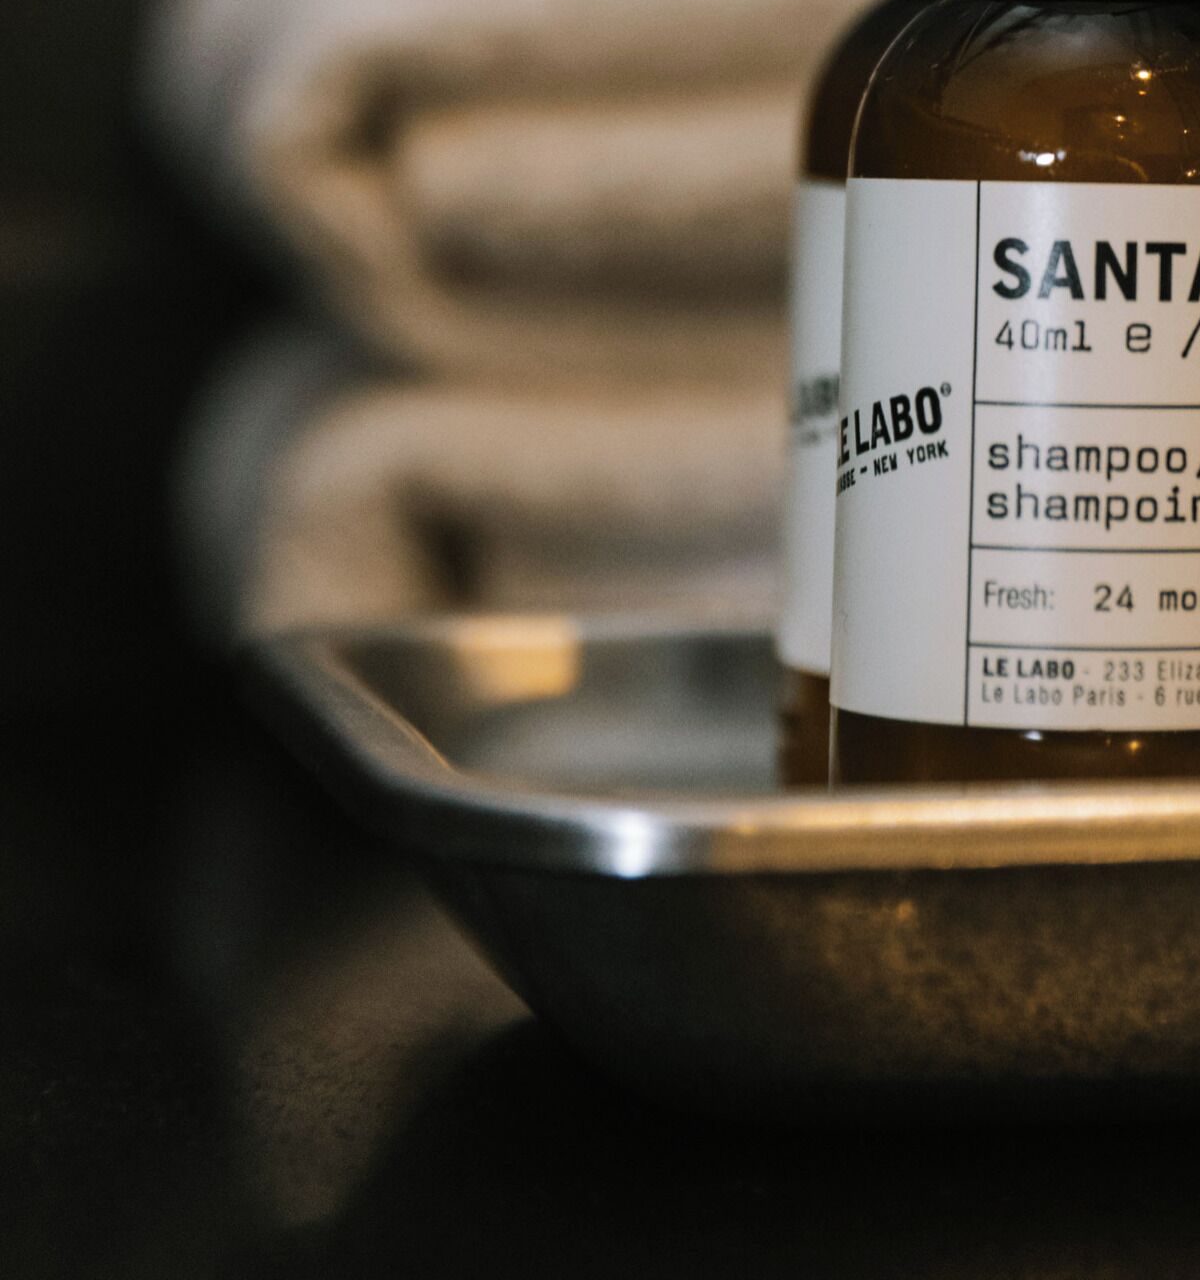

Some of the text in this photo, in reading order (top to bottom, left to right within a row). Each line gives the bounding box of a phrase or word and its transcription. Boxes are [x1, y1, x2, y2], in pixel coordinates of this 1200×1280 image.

[995, 320, 1092, 351] 40ml
[838, 416, 850, 469] E
[873, 453, 898, 476] NEW
[907, 440, 949, 465] YORK
[984, 581, 1054, 610] Fresh:
[1094, 584, 1133, 612] 24
[983, 658, 1008, 677] LE
[1017, 659, 1075, 680] LABO
[1105, 661, 1144, 682] 233
[982, 682, 1004, 703] Le
[1014, 683, 1063, 705] Labo
[1073, 684, 1126, 706] Paris
[1155, 686, 1166, 706] 6
